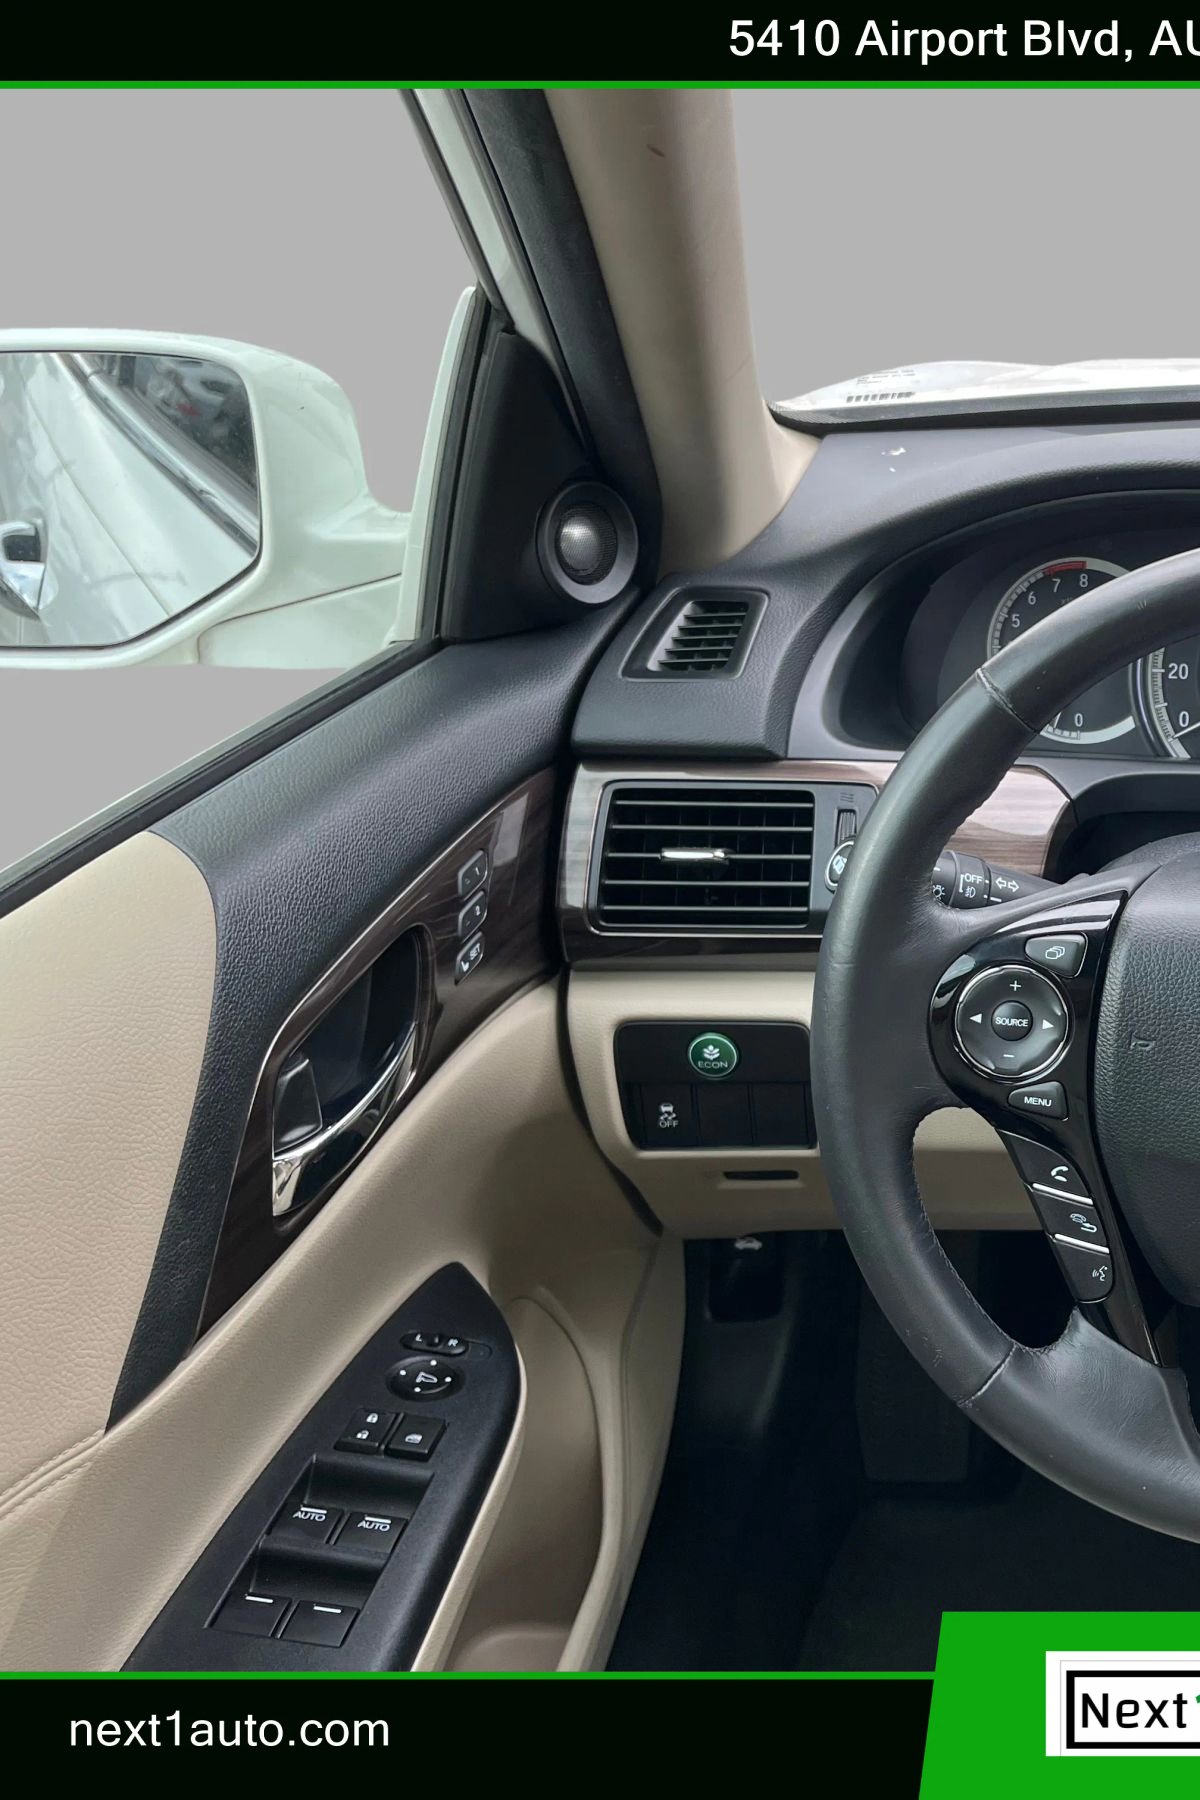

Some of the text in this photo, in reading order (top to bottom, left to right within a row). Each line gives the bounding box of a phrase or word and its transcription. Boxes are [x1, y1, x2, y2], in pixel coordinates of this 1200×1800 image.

[1052, 578, 1061, 593] 7
[1079, 573, 1088, 588] 8
[1028, 592, 1036, 605] 6
[1011, 614, 1020, 628] 5
[1168, 663, 1189, 680] 20
[1074, 713, 1083, 727] 0
[1179, 711, 1189, 727] 0
[964, 873, 983, 885] OFF
[995, 1016, 1029, 1027] SOURCE
[698, 1061, 728, 1069] ECON
[1024, 1096, 1052, 1107] MENU
[659, 1120, 678, 1128] OFF
[293, 1511, 326, 1522] AUTO
[358, 1520, 390, 1532] AUTO
